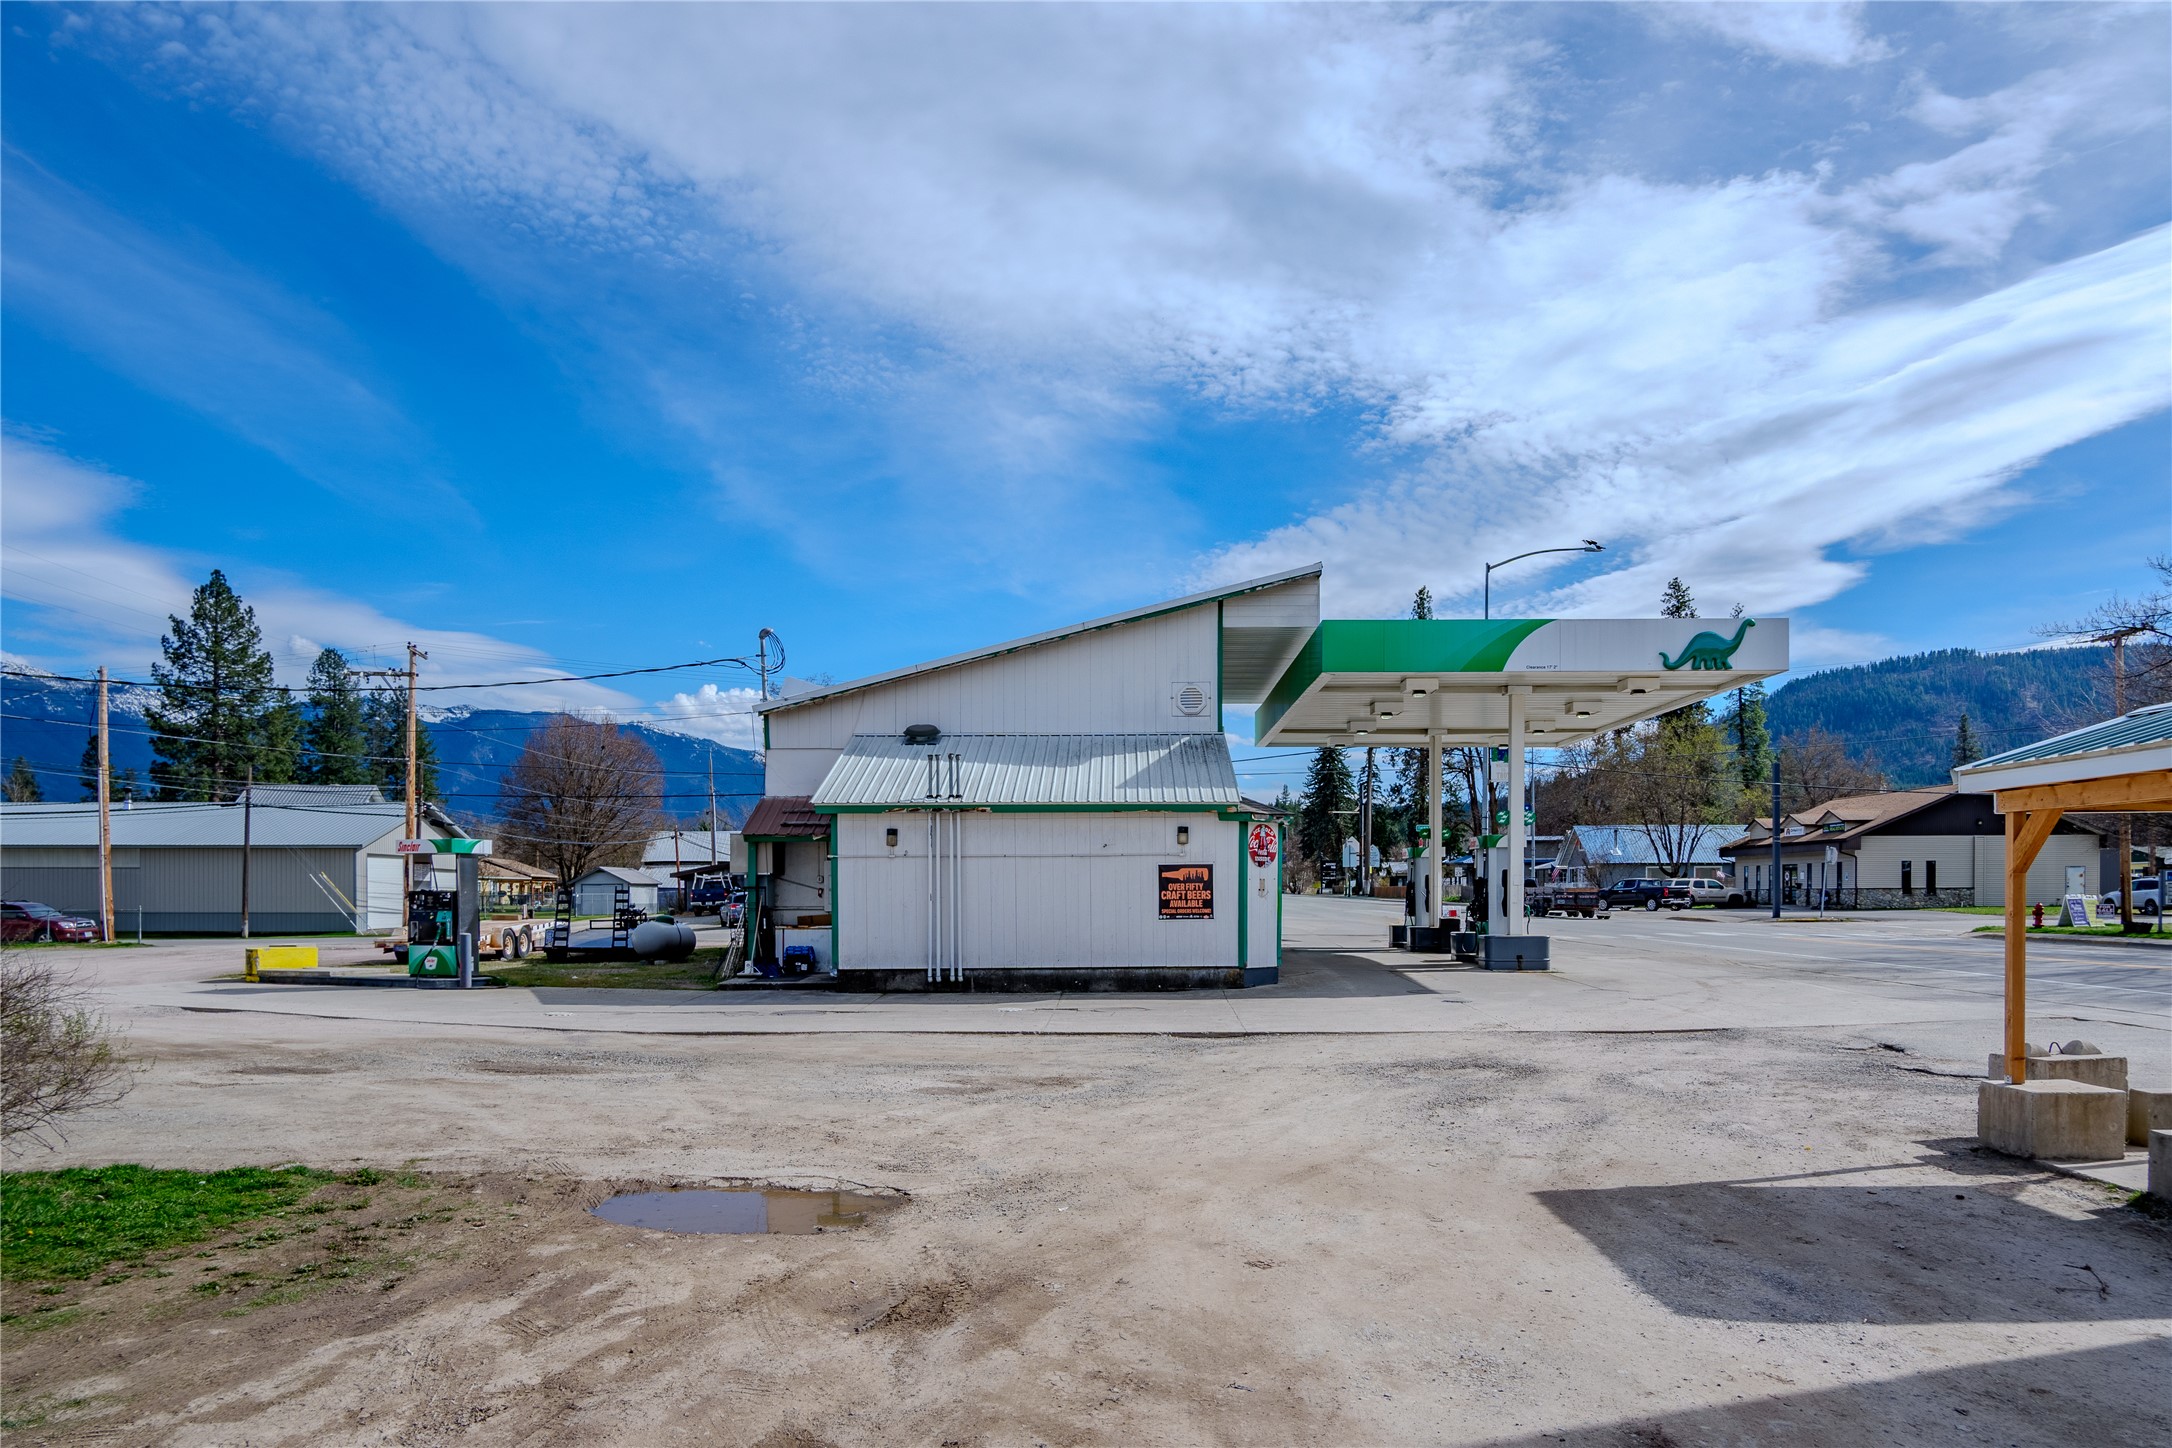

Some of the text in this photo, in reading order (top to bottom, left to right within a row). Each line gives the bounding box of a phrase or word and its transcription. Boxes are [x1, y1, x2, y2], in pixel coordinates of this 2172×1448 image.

[398, 841, 420, 852] Sinclair
[1161, 890, 1212, 900] CRAFT BEERS
